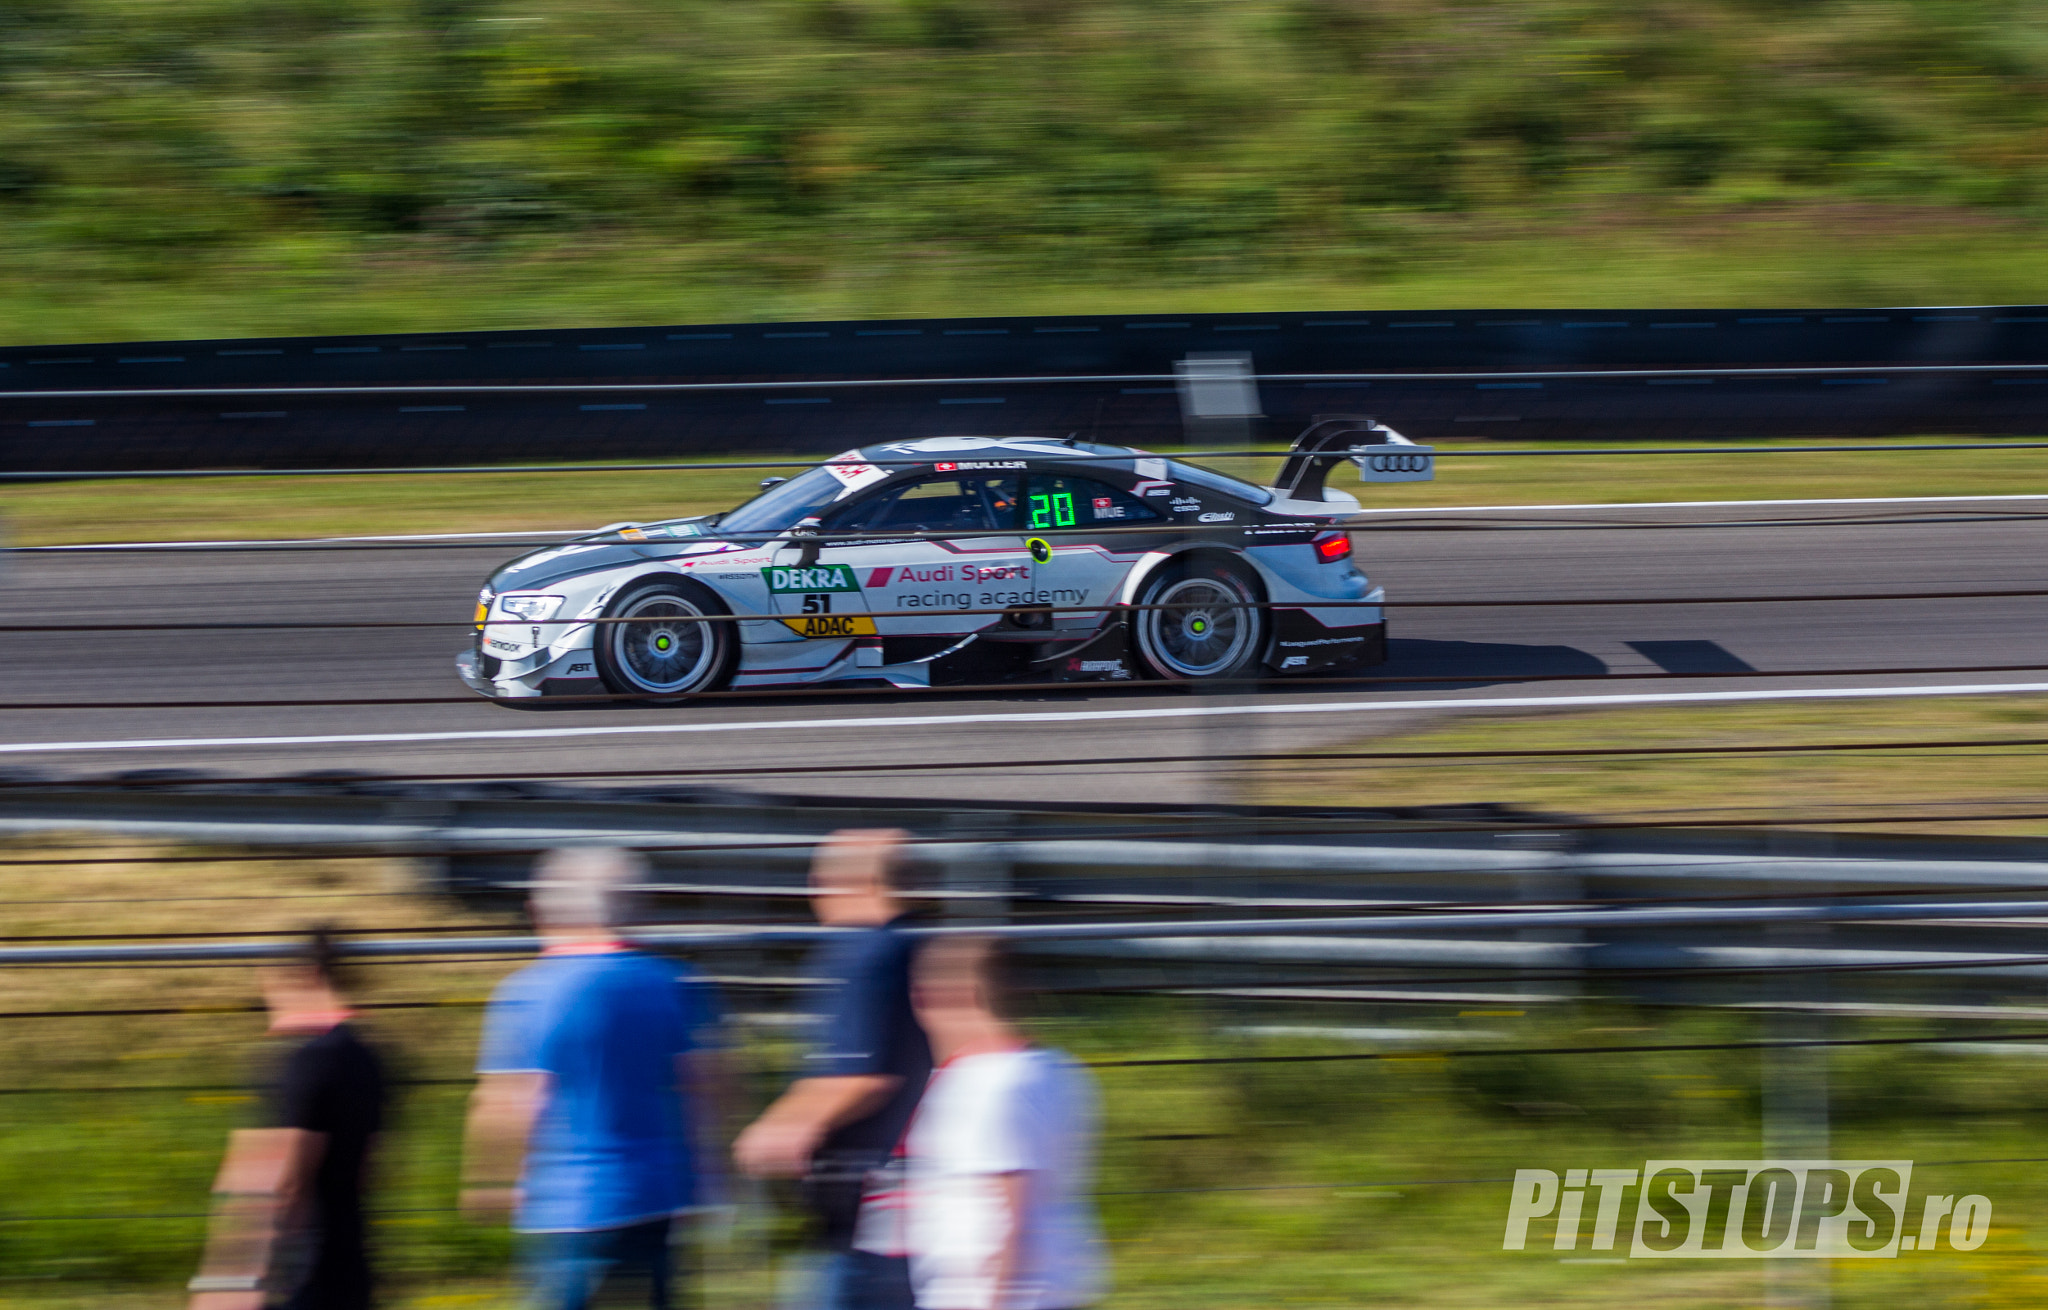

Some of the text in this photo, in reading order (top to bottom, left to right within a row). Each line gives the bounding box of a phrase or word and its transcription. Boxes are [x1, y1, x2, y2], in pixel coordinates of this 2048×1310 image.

[1030, 493, 1075, 528] 20
[733, 557, 773, 565] Sport
[772, 568, 848, 590] DEKRA
[898, 564, 1030, 584] Audi Sport
[803, 594, 831, 614] 51
[896, 588, 1090, 609] racing academy
[805, 616, 854, 635] ADAC
[566, 663, 592, 674] ABT
